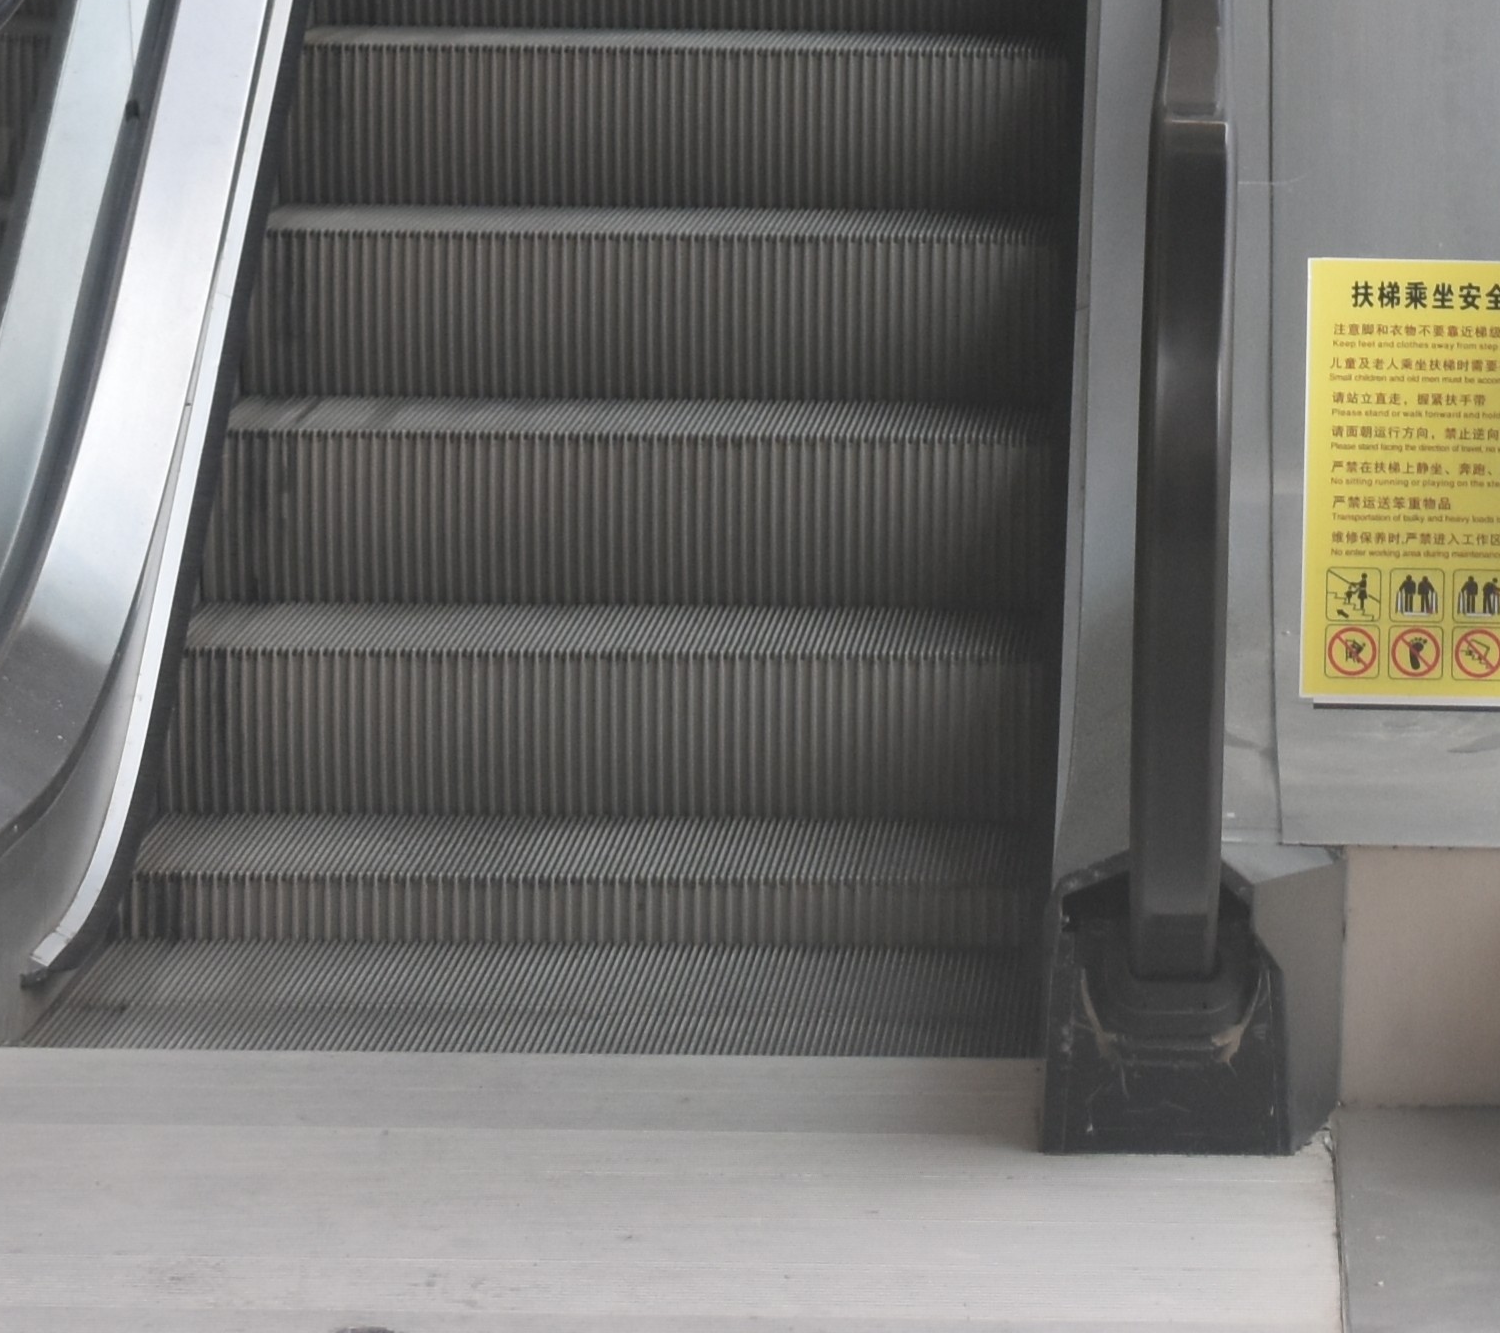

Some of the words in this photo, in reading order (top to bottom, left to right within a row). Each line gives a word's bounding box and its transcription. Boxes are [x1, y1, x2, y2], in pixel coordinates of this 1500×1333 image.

[1332, 495, 1452, 510] 严禁运送笨重物品
